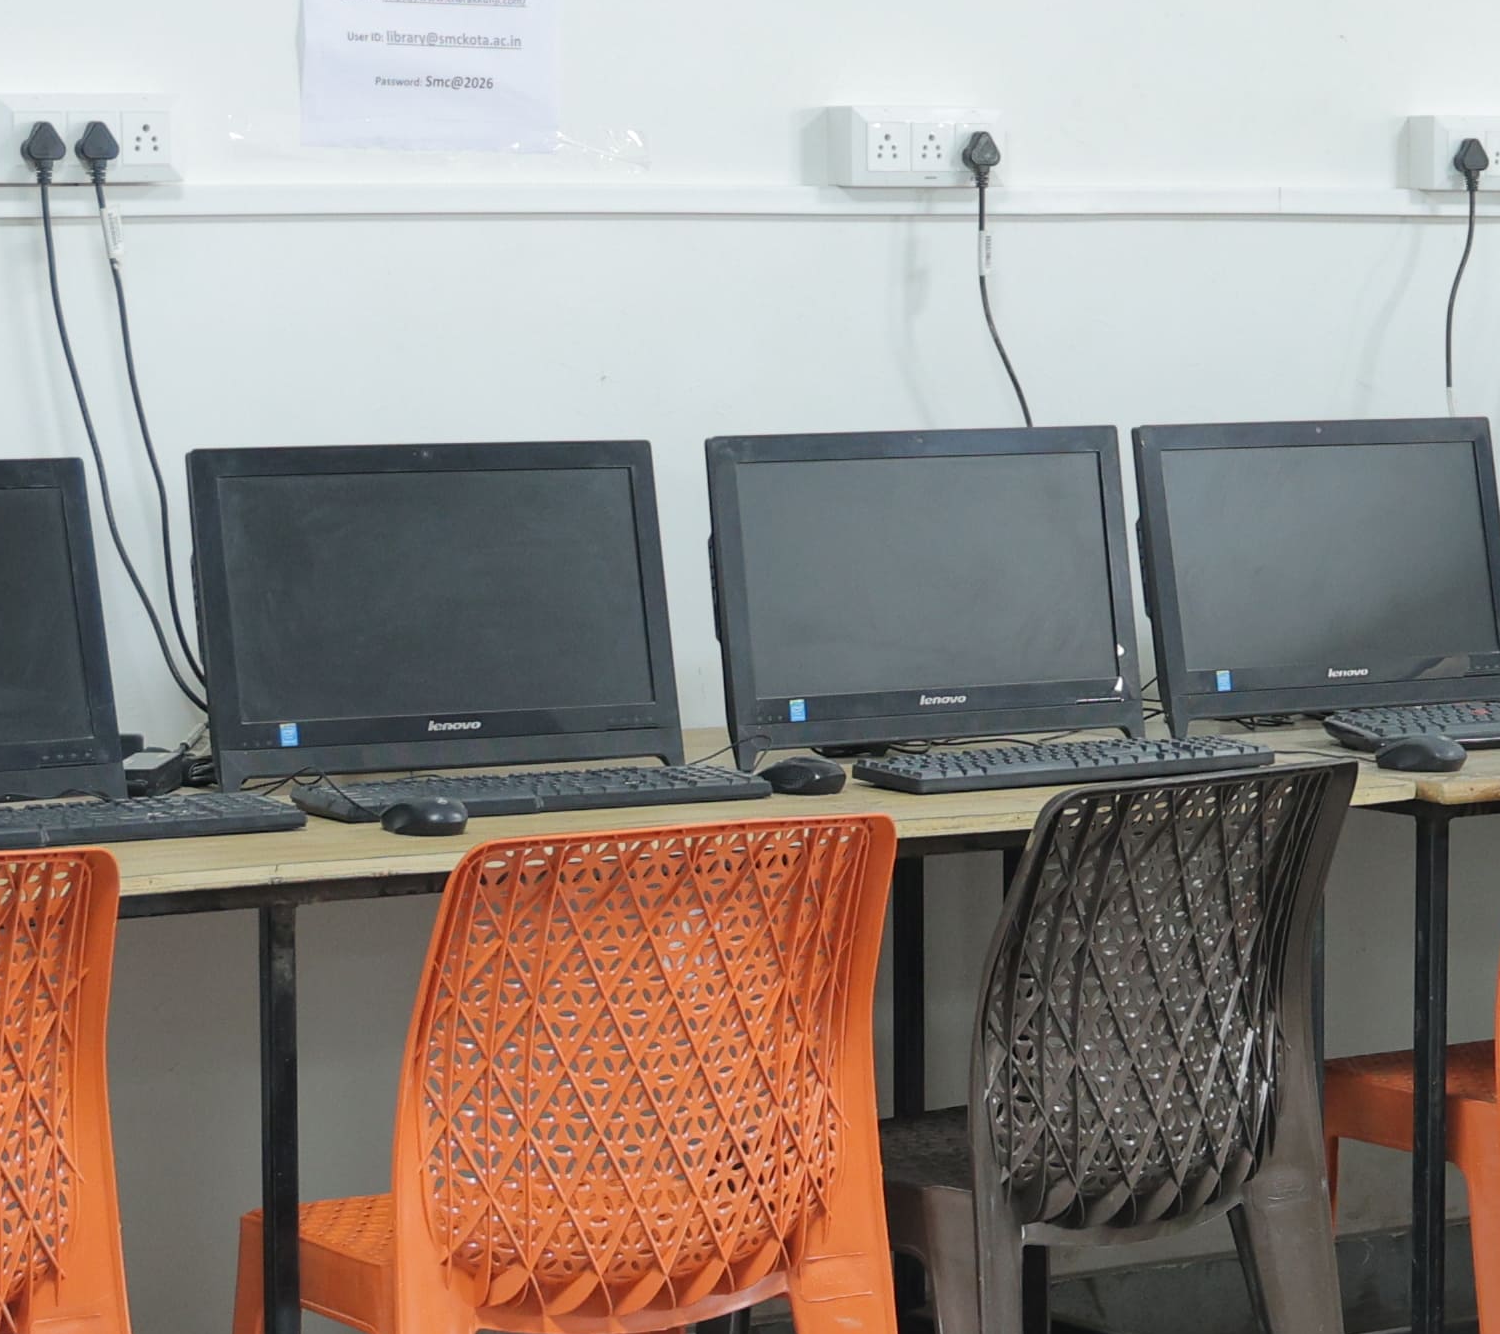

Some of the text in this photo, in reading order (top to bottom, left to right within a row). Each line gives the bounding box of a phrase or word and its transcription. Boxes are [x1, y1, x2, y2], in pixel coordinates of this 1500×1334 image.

[347, 29, 522, 49] User ID: library@smckota.ac.in
[374, 75, 494, 90] Password: Smc@2026
[1327, 668, 1369, 679] lenovo
[919, 694, 967, 706] lenovo
[427, 720, 482, 732] lenovo
